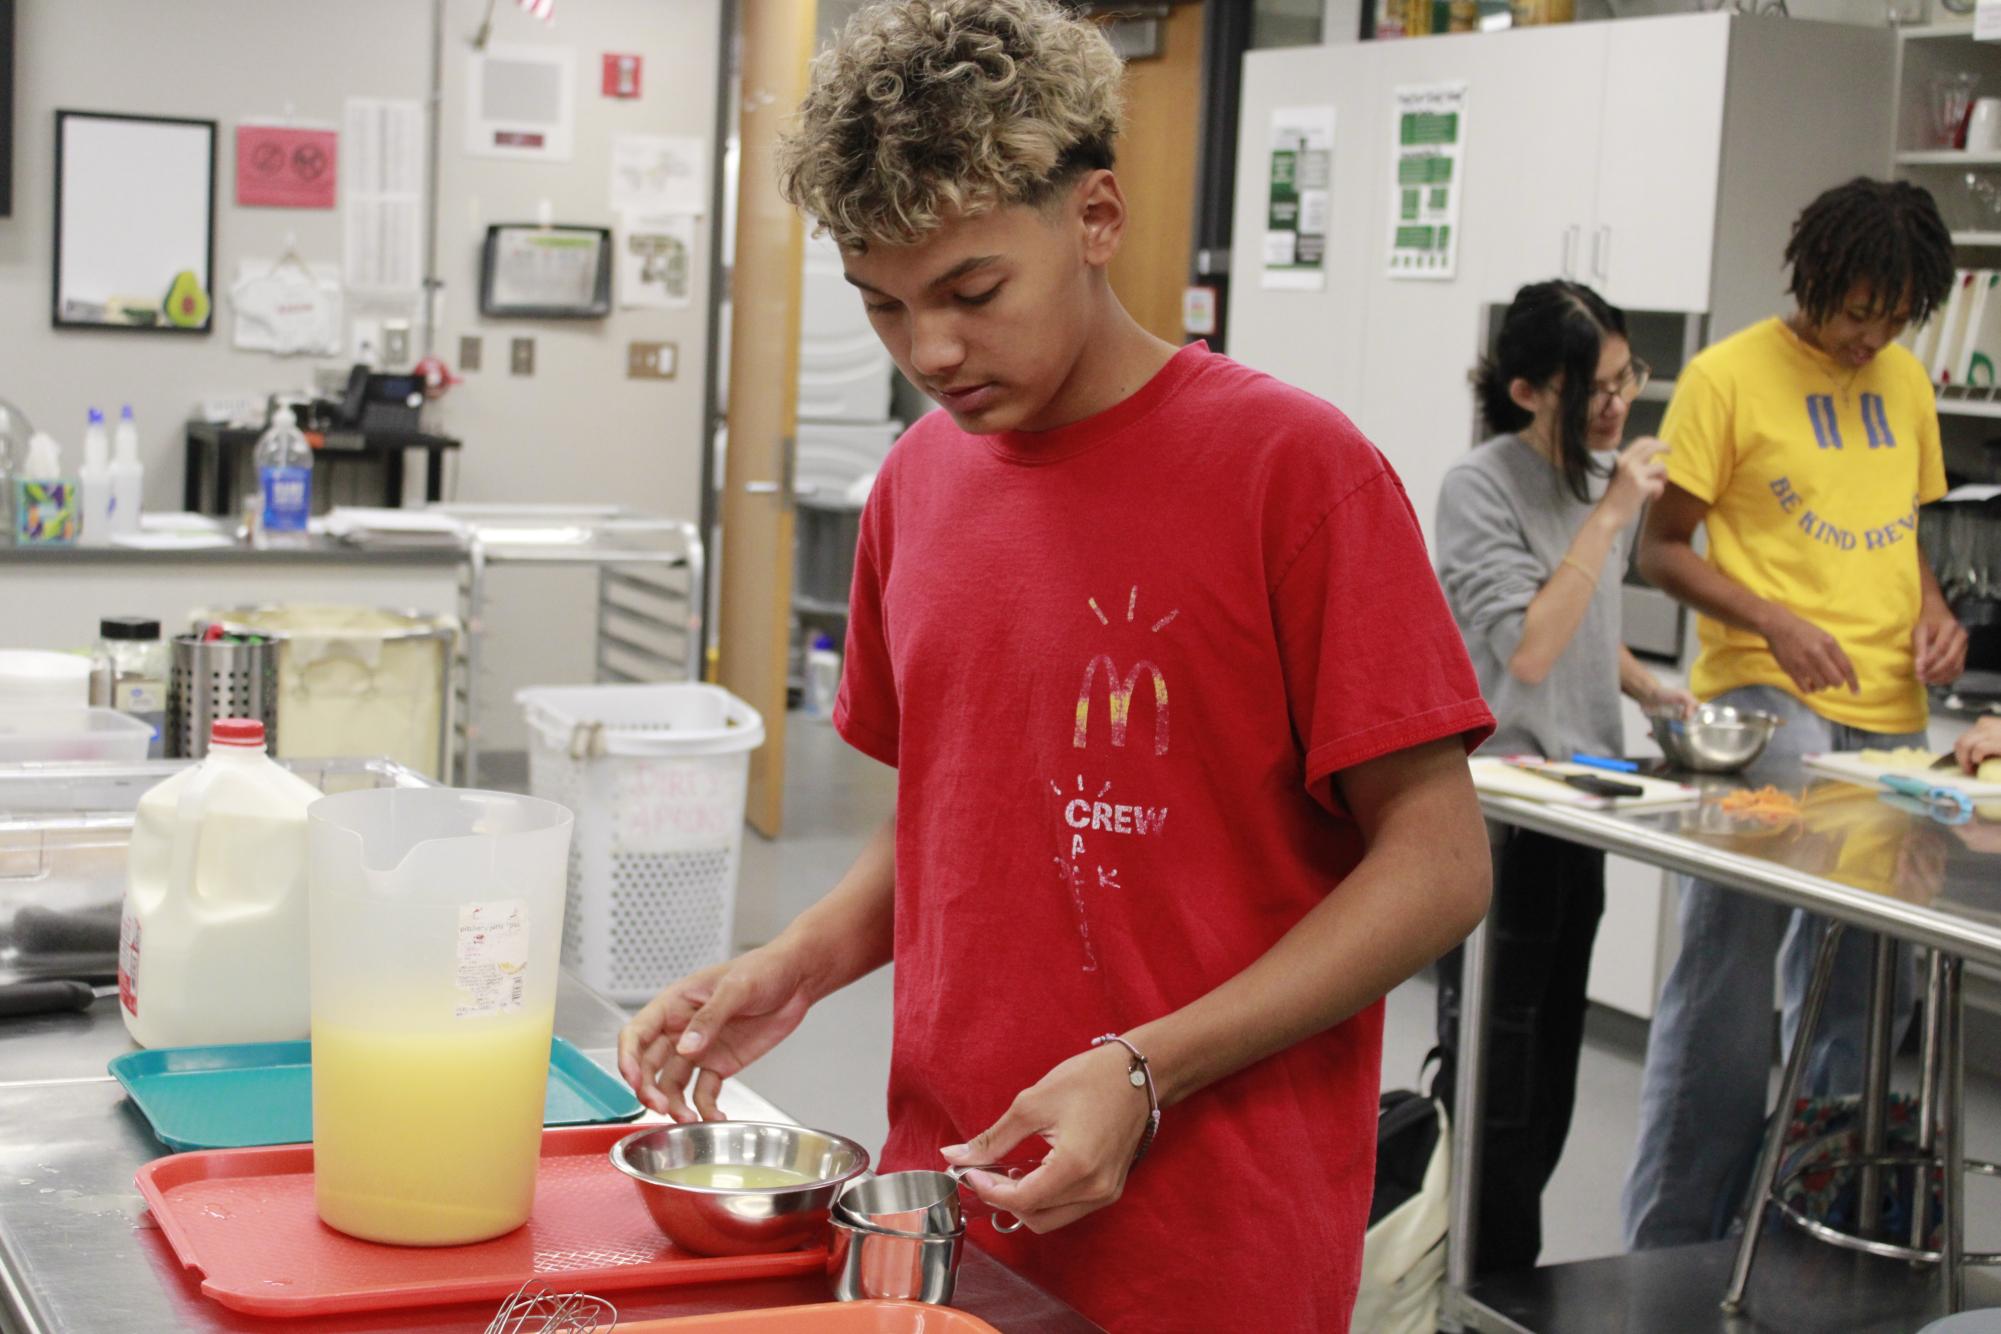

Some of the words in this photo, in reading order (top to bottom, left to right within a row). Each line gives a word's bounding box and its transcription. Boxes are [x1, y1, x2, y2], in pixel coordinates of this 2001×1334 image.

[1769, 476, 1801, 515] BE
[1798, 509, 1857, 551] KIND
[1065, 798, 1169, 836] CREW
